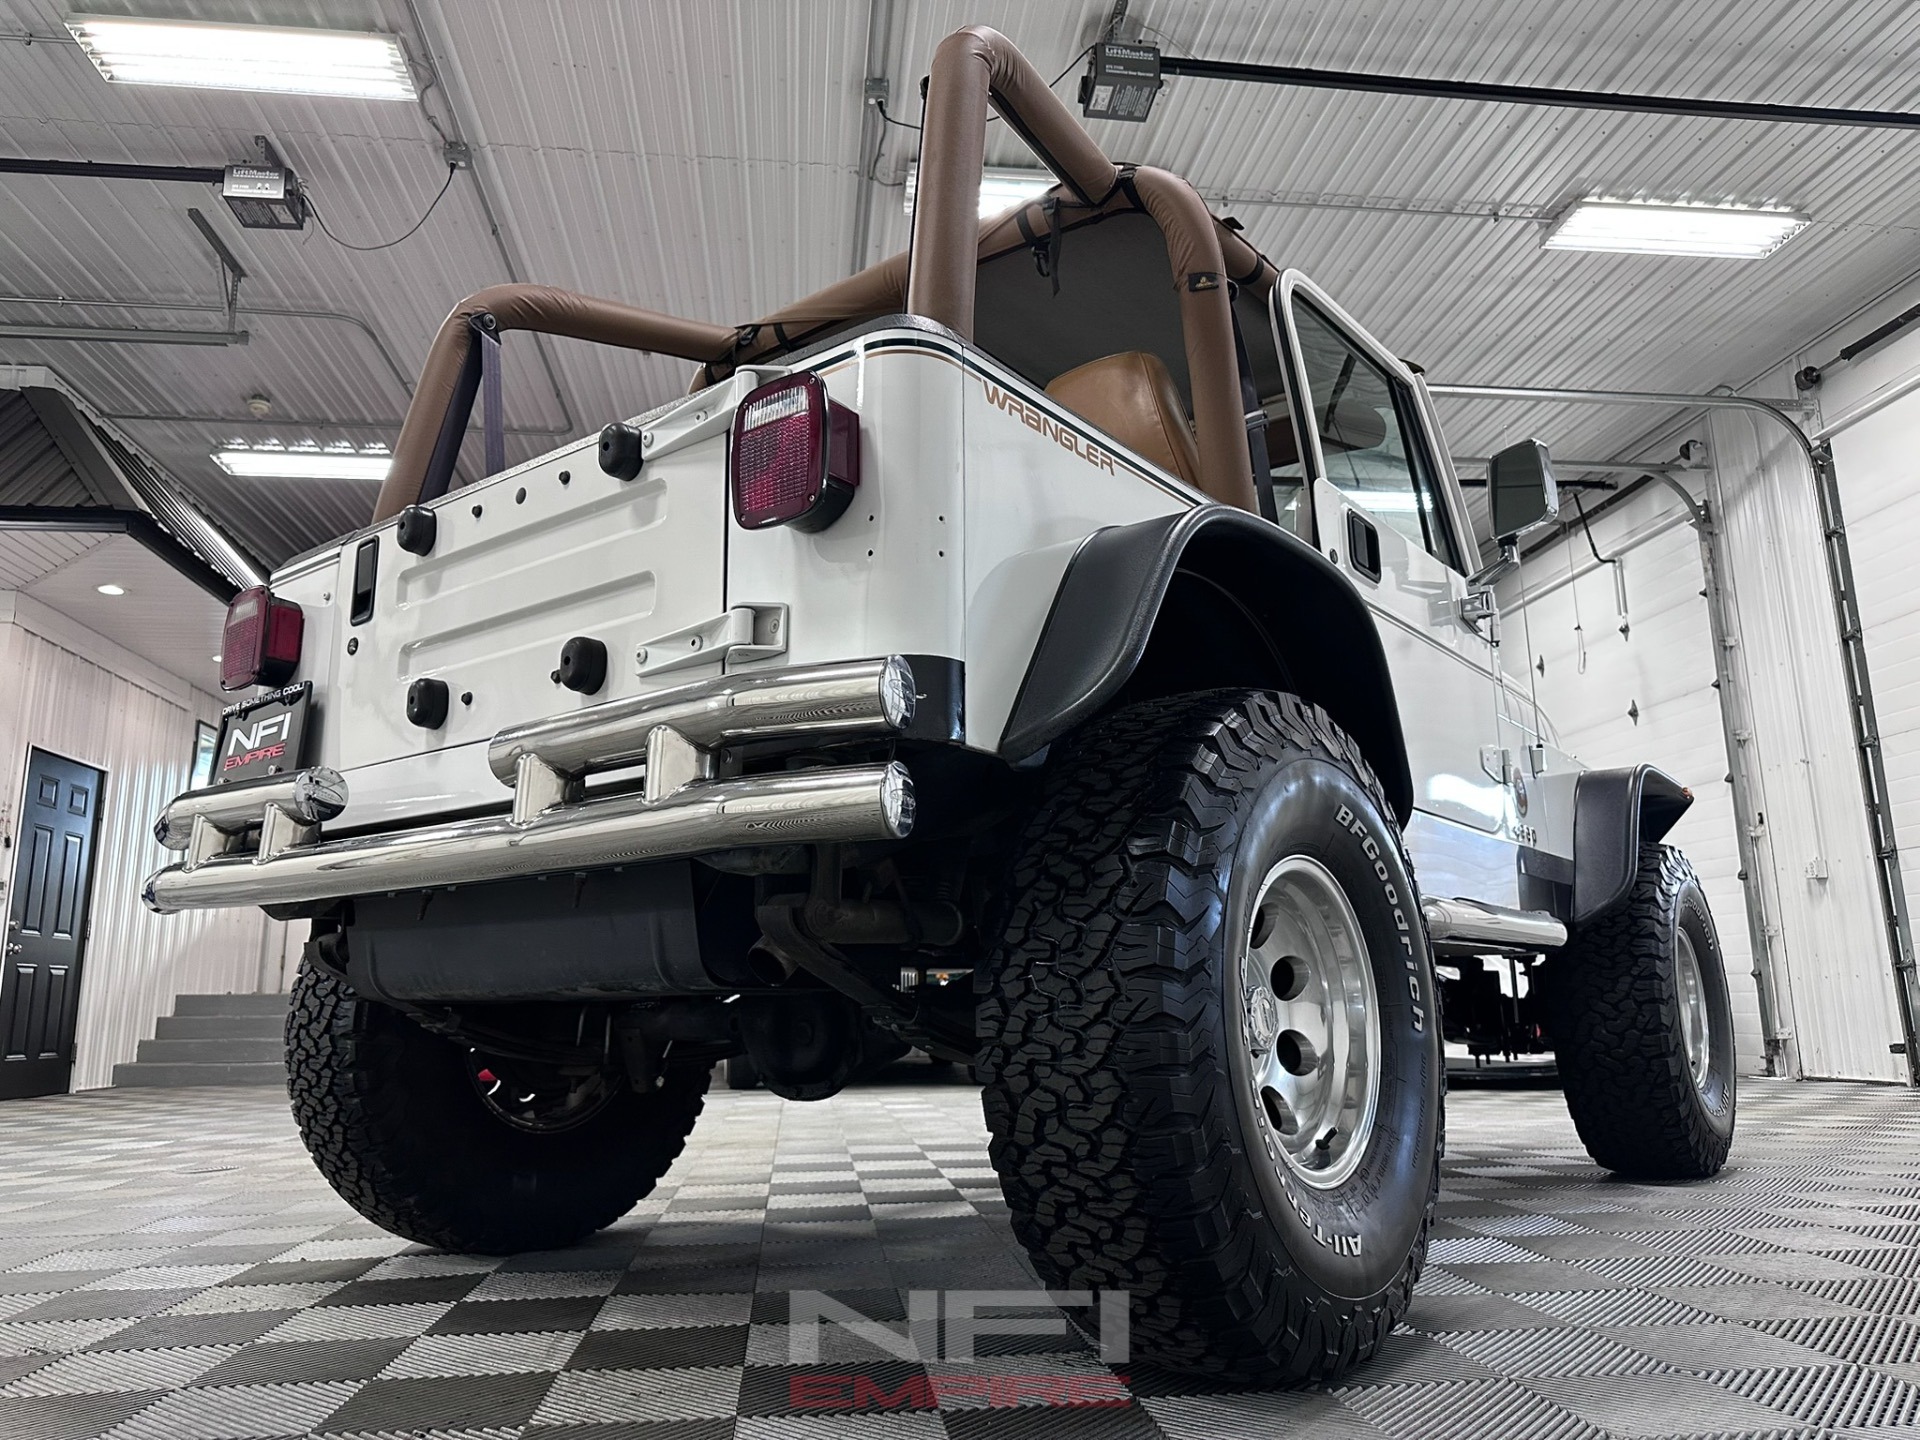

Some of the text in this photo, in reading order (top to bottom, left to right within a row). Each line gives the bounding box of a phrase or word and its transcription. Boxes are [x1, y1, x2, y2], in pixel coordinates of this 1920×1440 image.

[1105, 47, 1154, 57] LiftMaster
[233, 168, 279, 176] LiftMaster
[982, 379, 1115, 477] WRANGLER
[222, 682, 305, 715] DRIVE SOMETHING COOL!
[227, 711, 292, 757] NFI
[223, 742, 287, 771] EMPIRE
[1335, 803, 1425, 1033] BFGoodrich
[1251, 1079, 1363, 1257] All-Terrain
